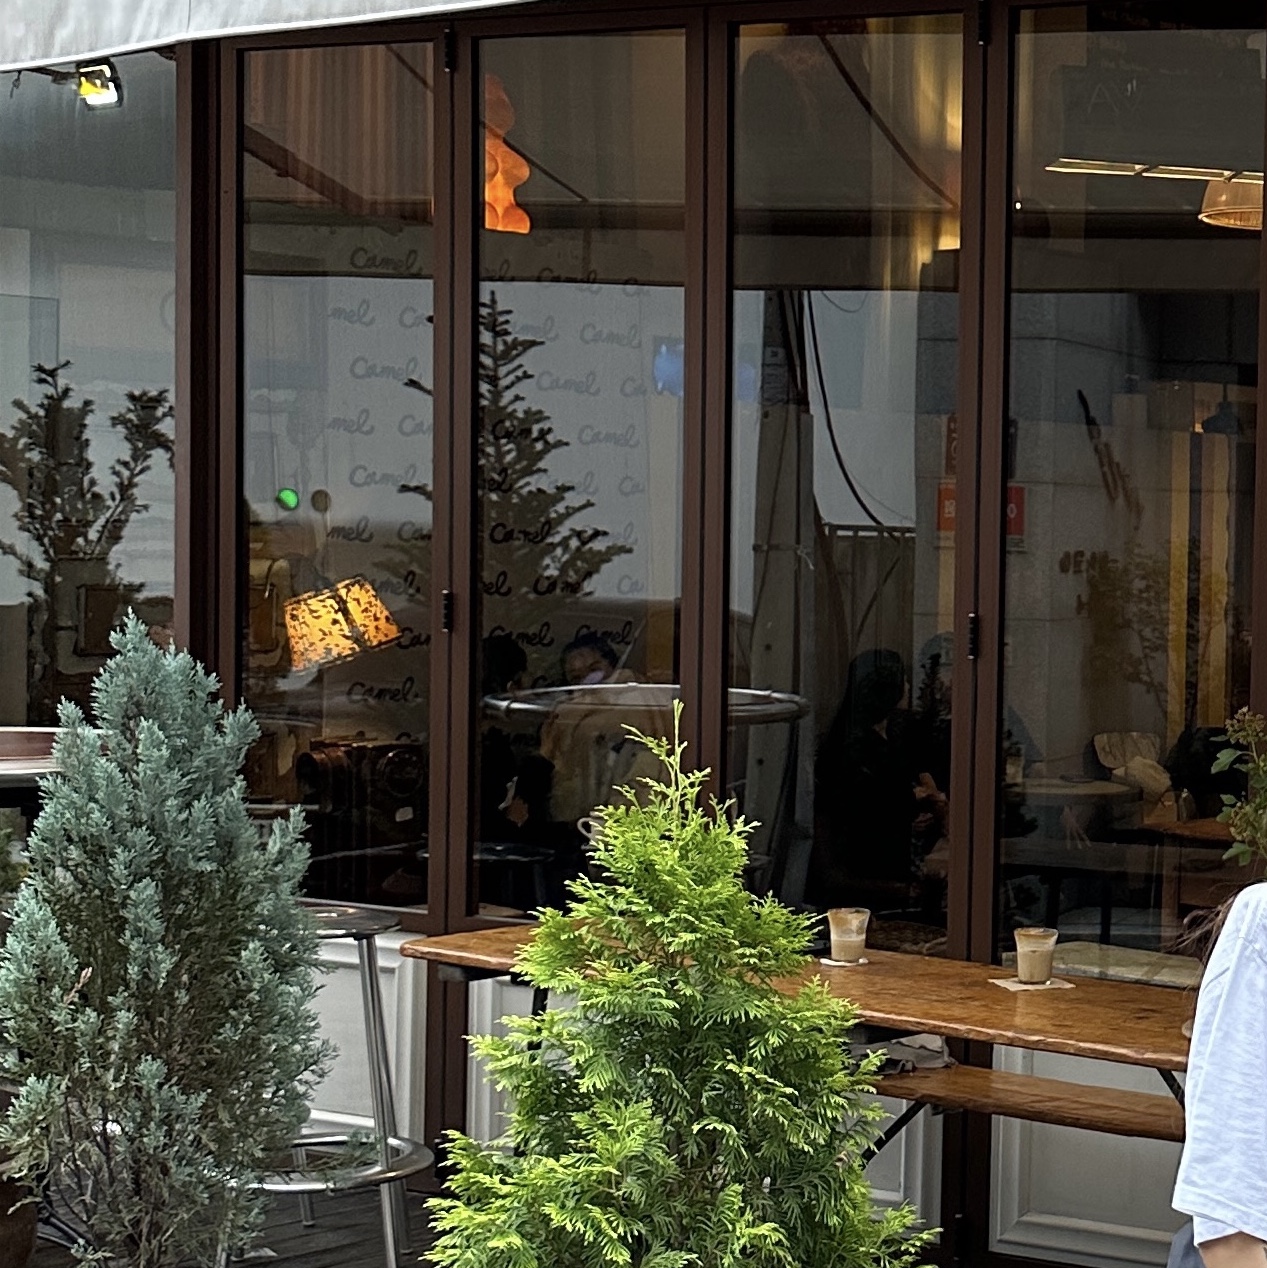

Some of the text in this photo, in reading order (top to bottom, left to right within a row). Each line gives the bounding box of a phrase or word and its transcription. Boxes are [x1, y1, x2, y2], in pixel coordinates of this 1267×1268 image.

[580, 322, 642, 349] Camel
[536, 370, 601, 396] Camel
[577, 424, 641, 449] Camel
